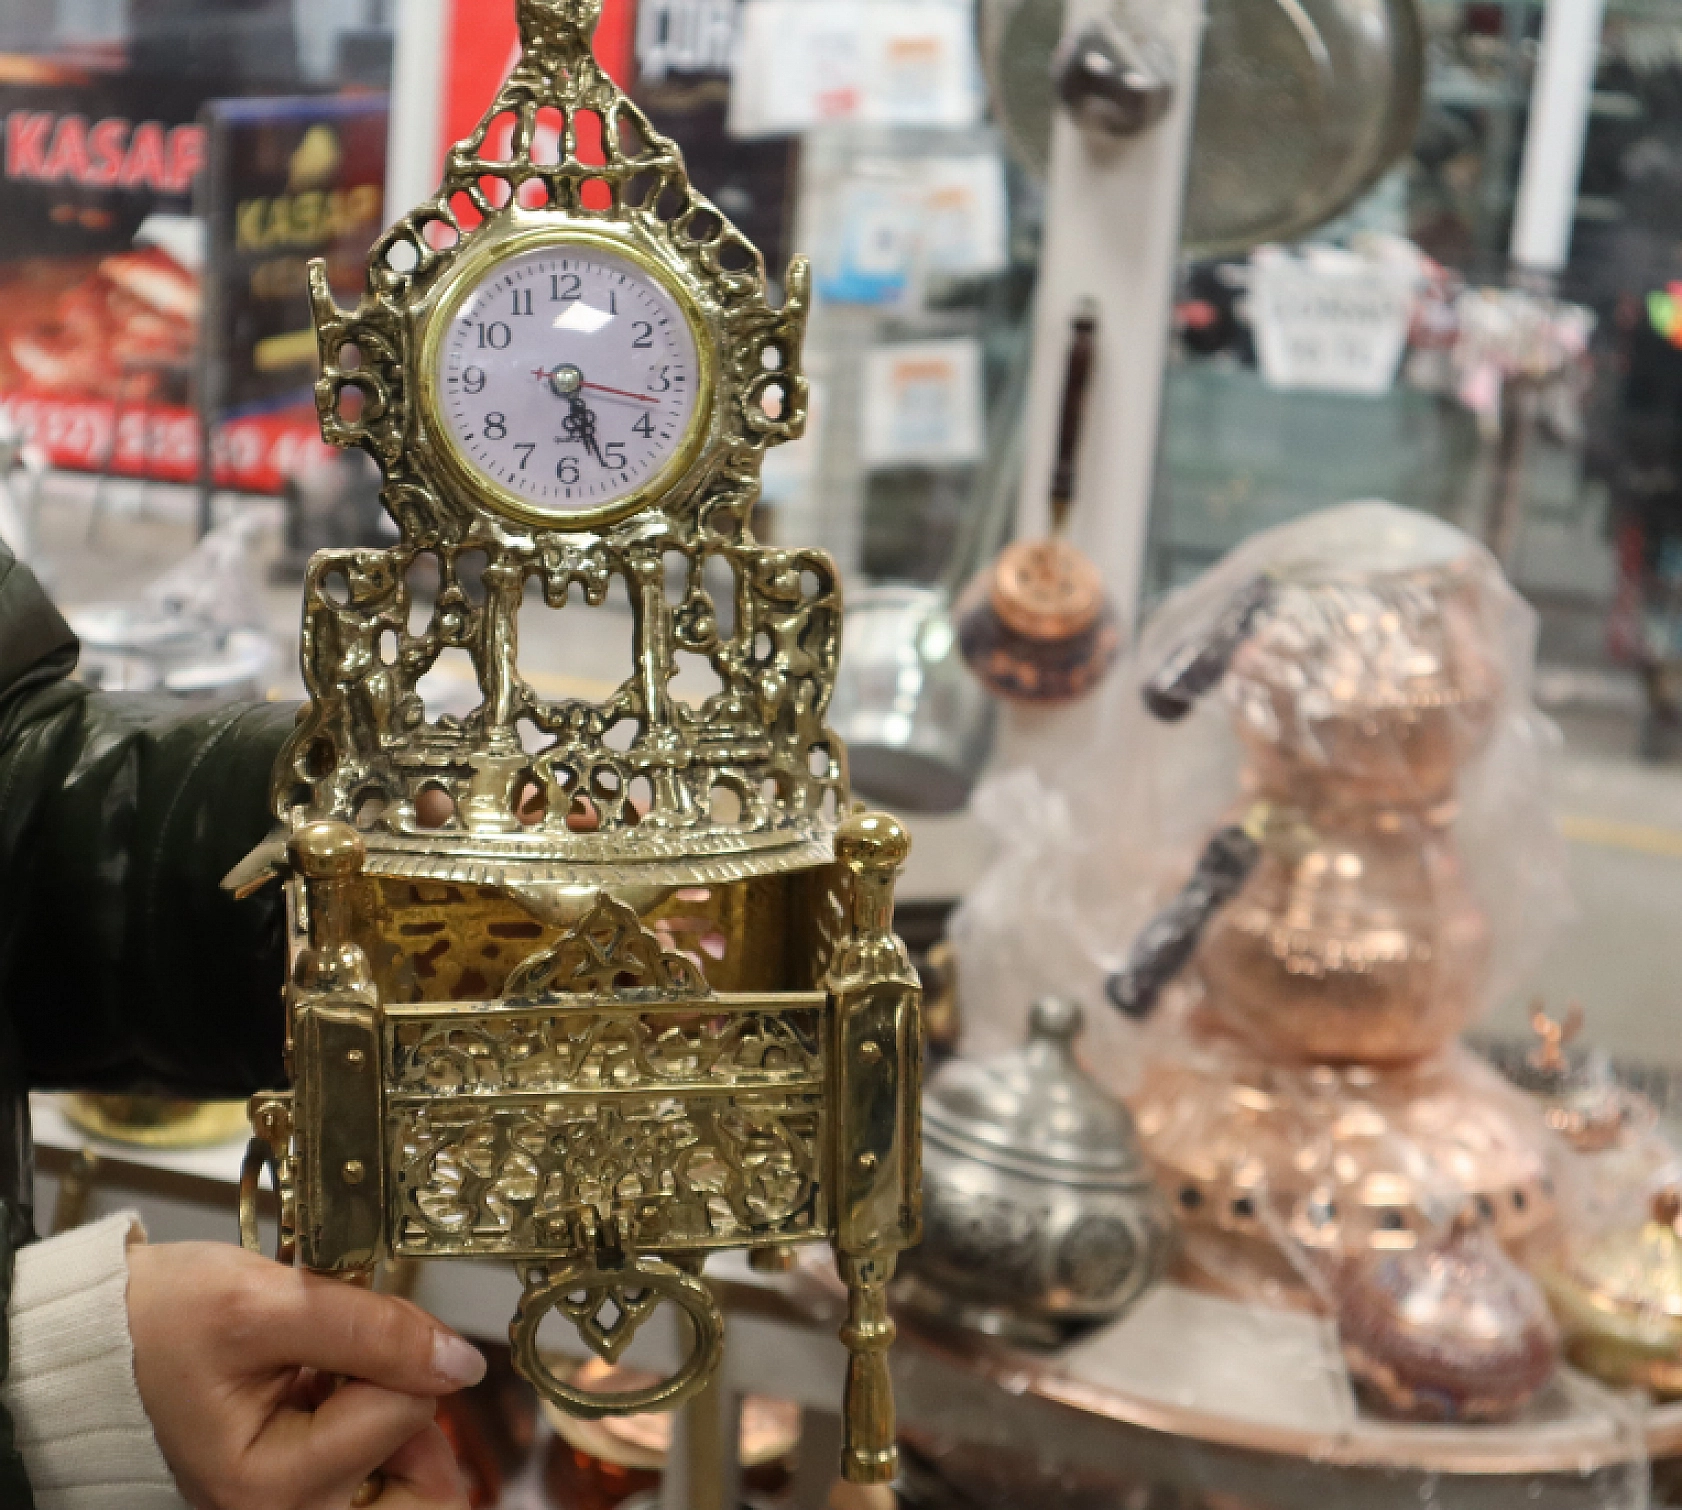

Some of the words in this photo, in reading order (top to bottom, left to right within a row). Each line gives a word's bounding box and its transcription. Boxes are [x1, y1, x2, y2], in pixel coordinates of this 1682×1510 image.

[550, 273, 582, 301] 12
[510, 288, 534, 316] 11
[609, 290, 619, 315] 1
[477, 321, 512, 350] 10
[631, 321, 653, 348] 2
[462, 365, 486, 394] 9
[647, 365, 670, 392] 3
[483, 411, 507, 440] 8
[631, 411, 655, 439] 4
[513, 442, 536, 470] 7
[601, 442, 627, 469] 5
[556, 456, 580, 485] 6
